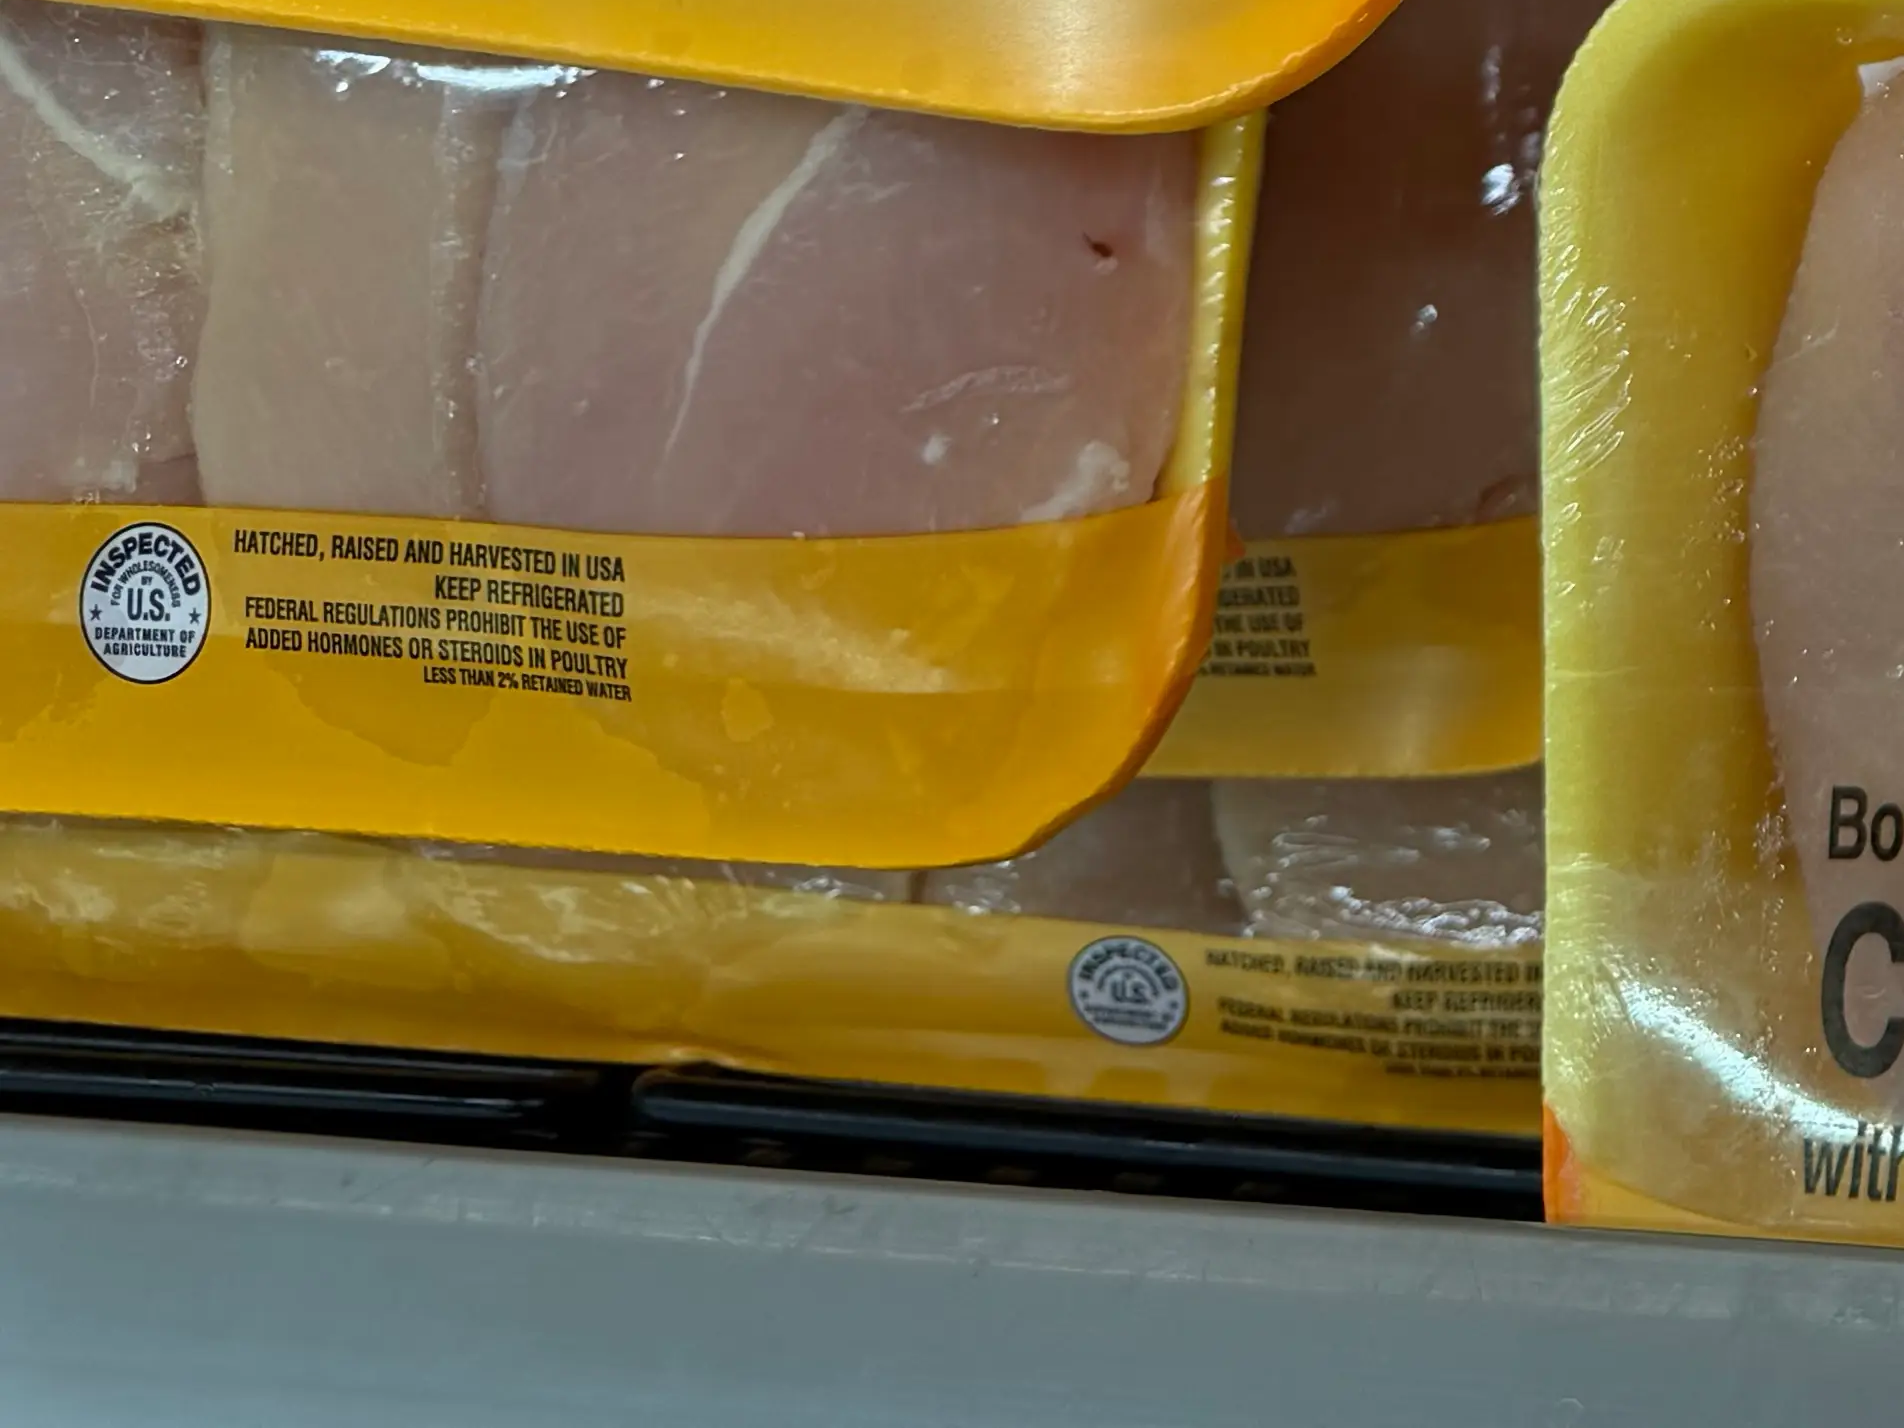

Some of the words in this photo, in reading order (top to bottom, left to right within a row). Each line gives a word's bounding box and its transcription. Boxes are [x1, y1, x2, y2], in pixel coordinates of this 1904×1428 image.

[90, 531, 201, 597] INSPECTED
[234, 529, 325, 563] HATCHED,
[331, 535, 399, 562] RAISED
[404, 542, 444, 565] AND
[449, 544, 556, 576] HARVESTED
[561, 554, 580, 578] IN
[585, 557, 625, 583] USA
[126, 586, 171, 622] U.S.
